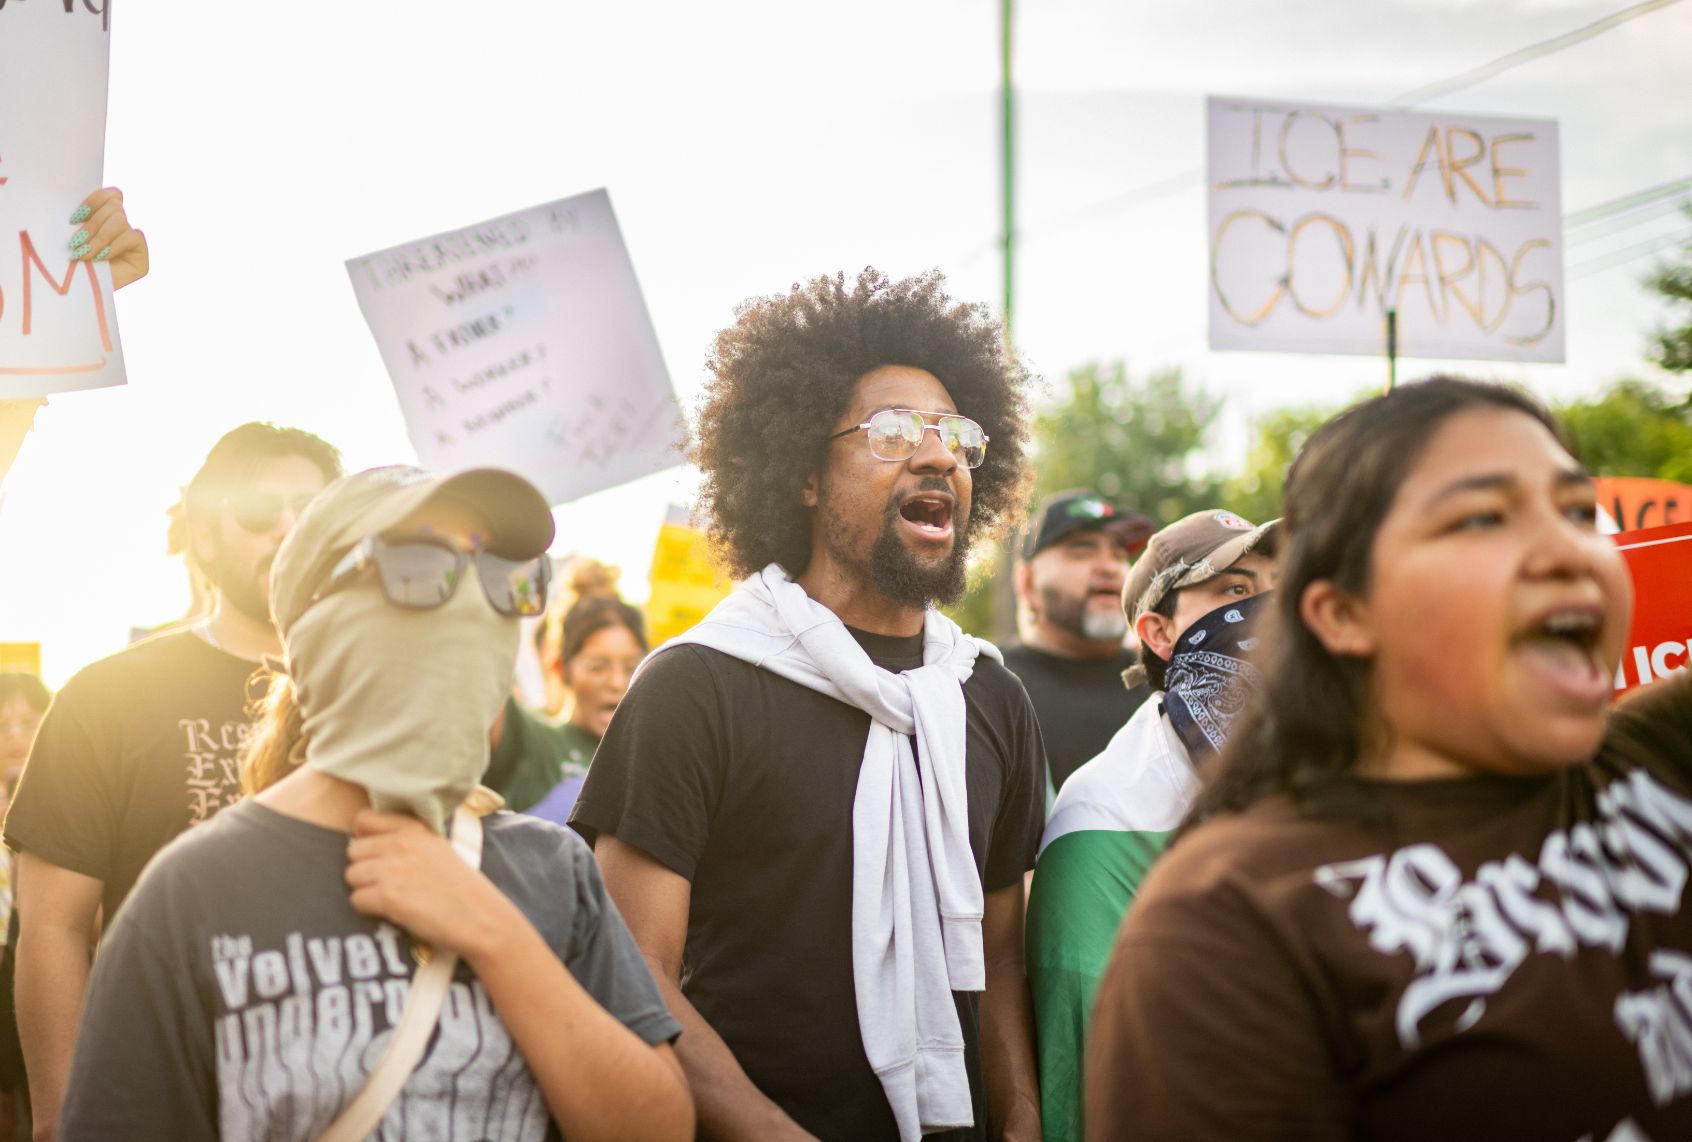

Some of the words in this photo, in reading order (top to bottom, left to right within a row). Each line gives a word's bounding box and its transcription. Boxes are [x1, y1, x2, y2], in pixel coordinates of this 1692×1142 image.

[1403, 124, 1543, 210] ARE
[0, 229, 113, 353] M
[1210, 206, 1556, 347] COWARDS
